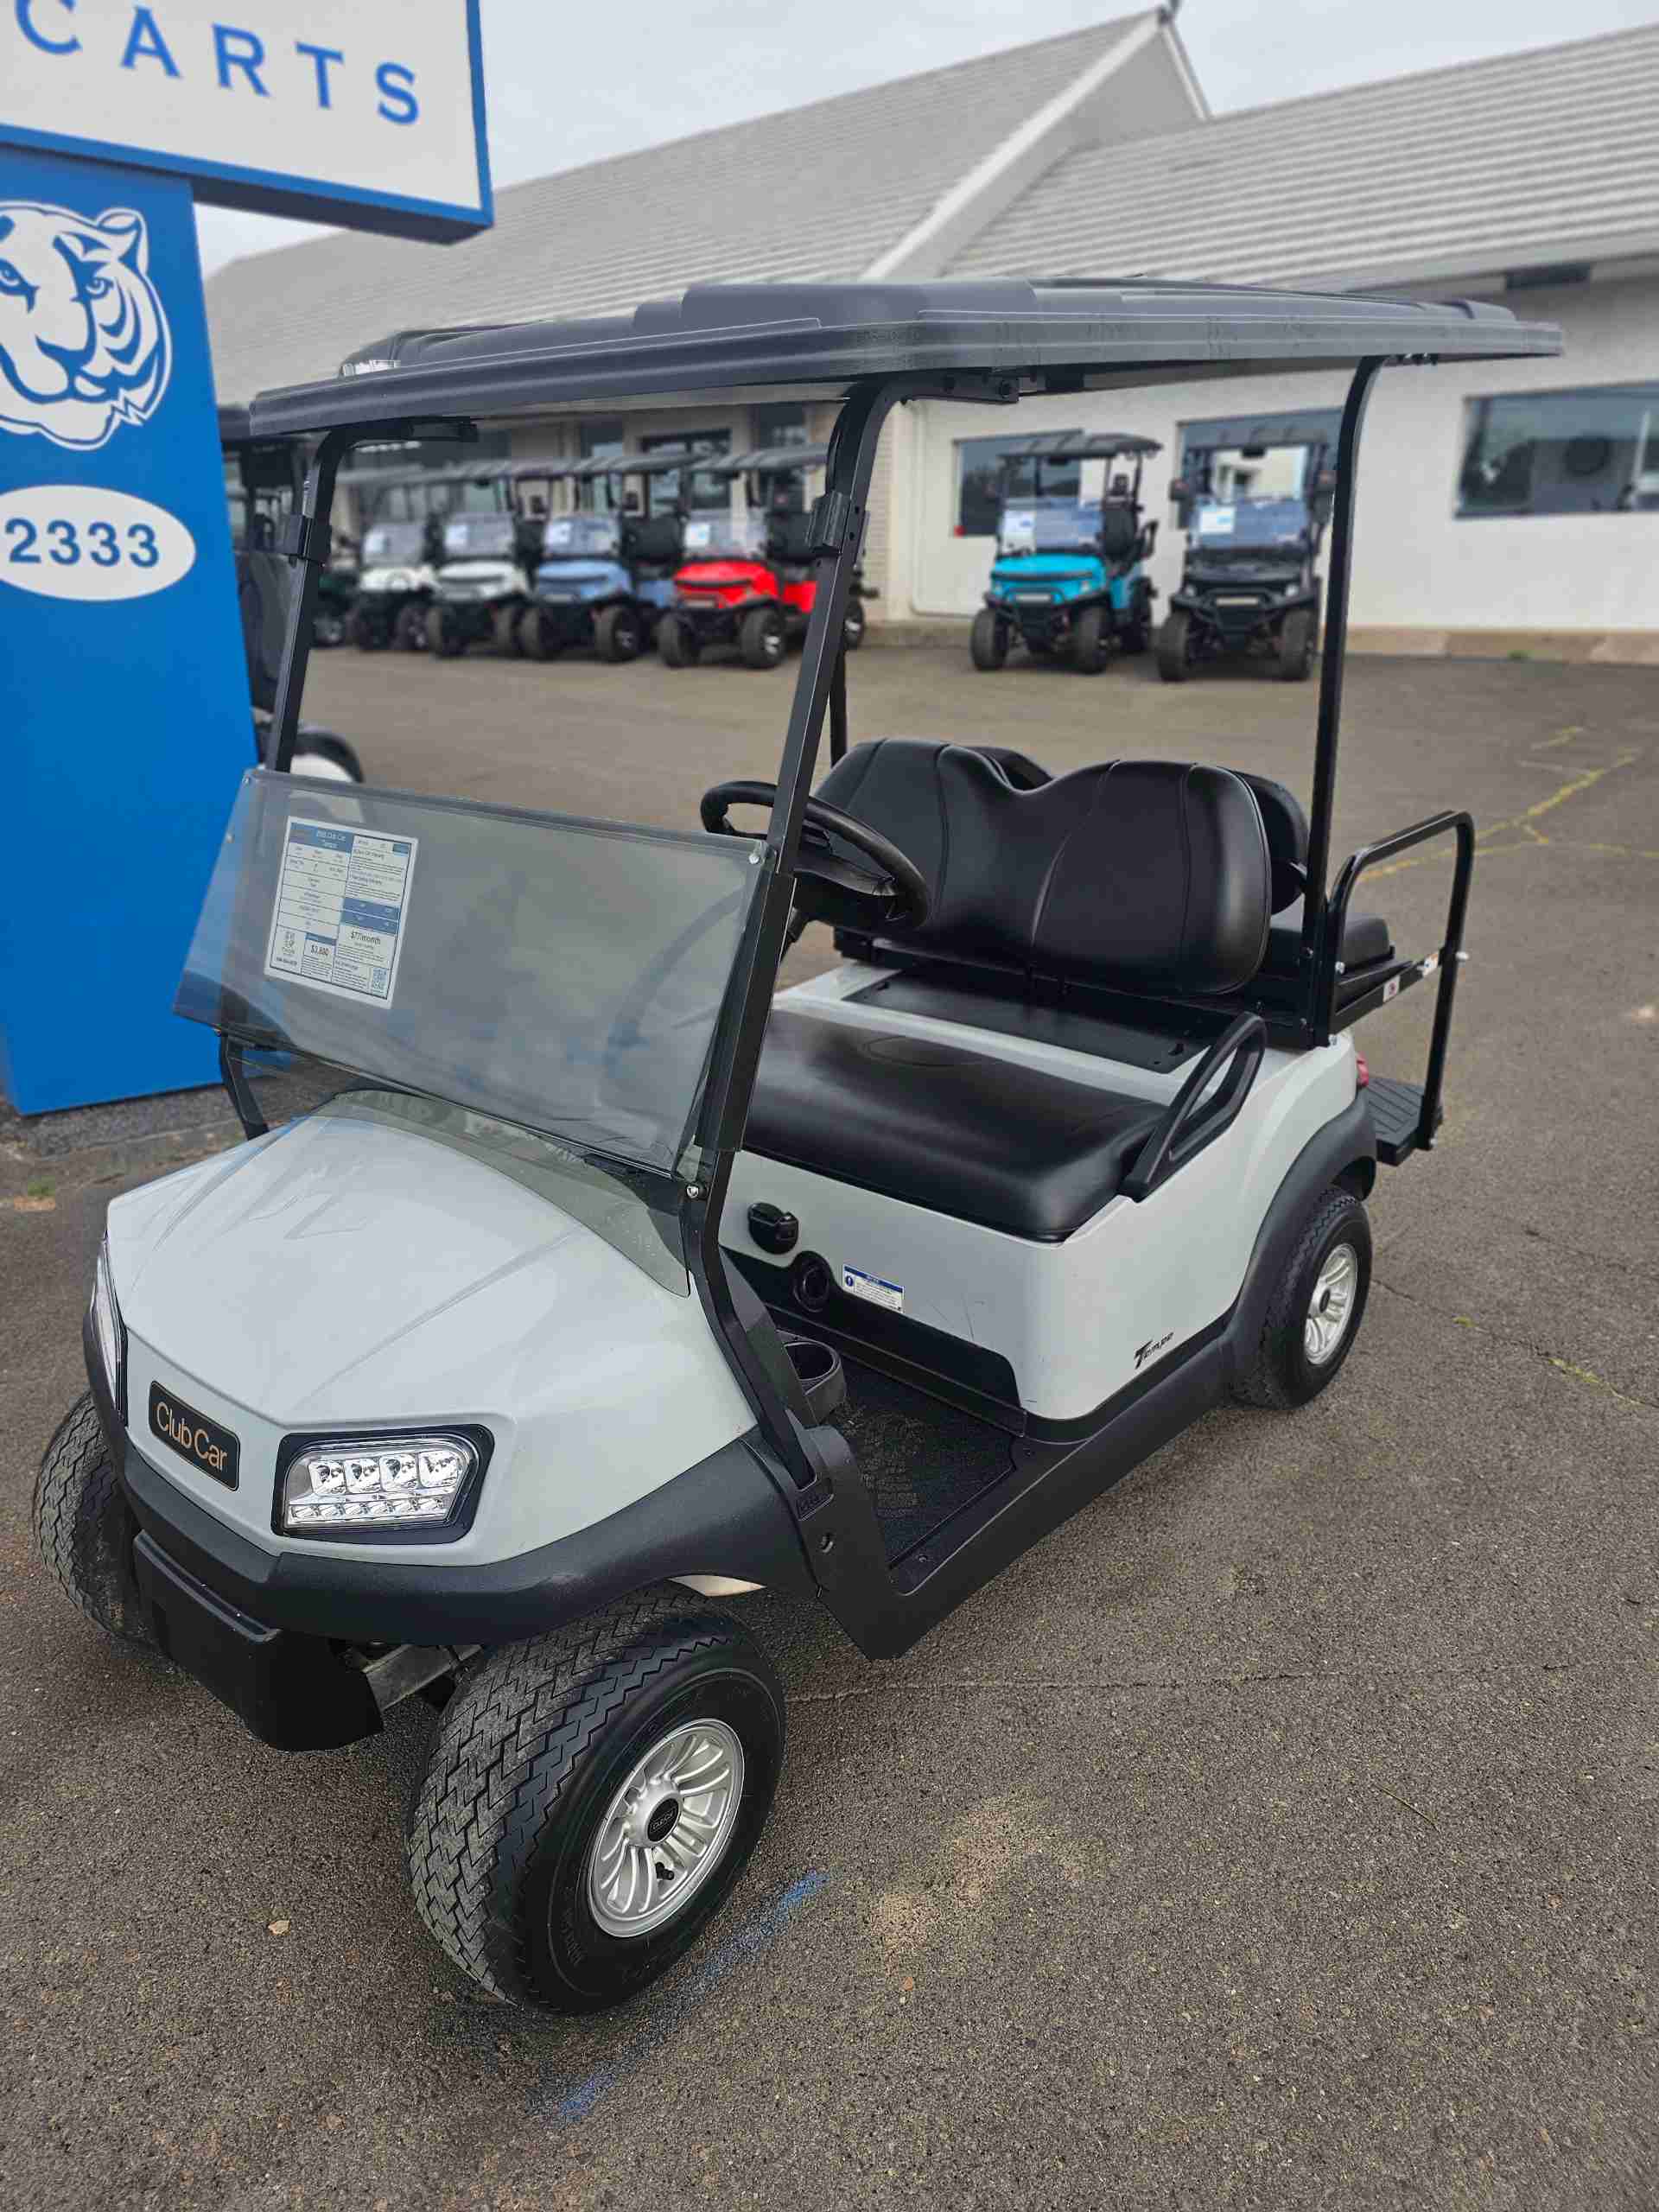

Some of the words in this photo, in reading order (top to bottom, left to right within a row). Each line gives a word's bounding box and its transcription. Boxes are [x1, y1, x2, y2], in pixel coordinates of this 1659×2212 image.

[15, 0, 421, 126] CARTS
[5, 517, 159, 569] 2333
[156, 1401, 193, 1449] Club
[194, 1428, 228, 1471] Car
